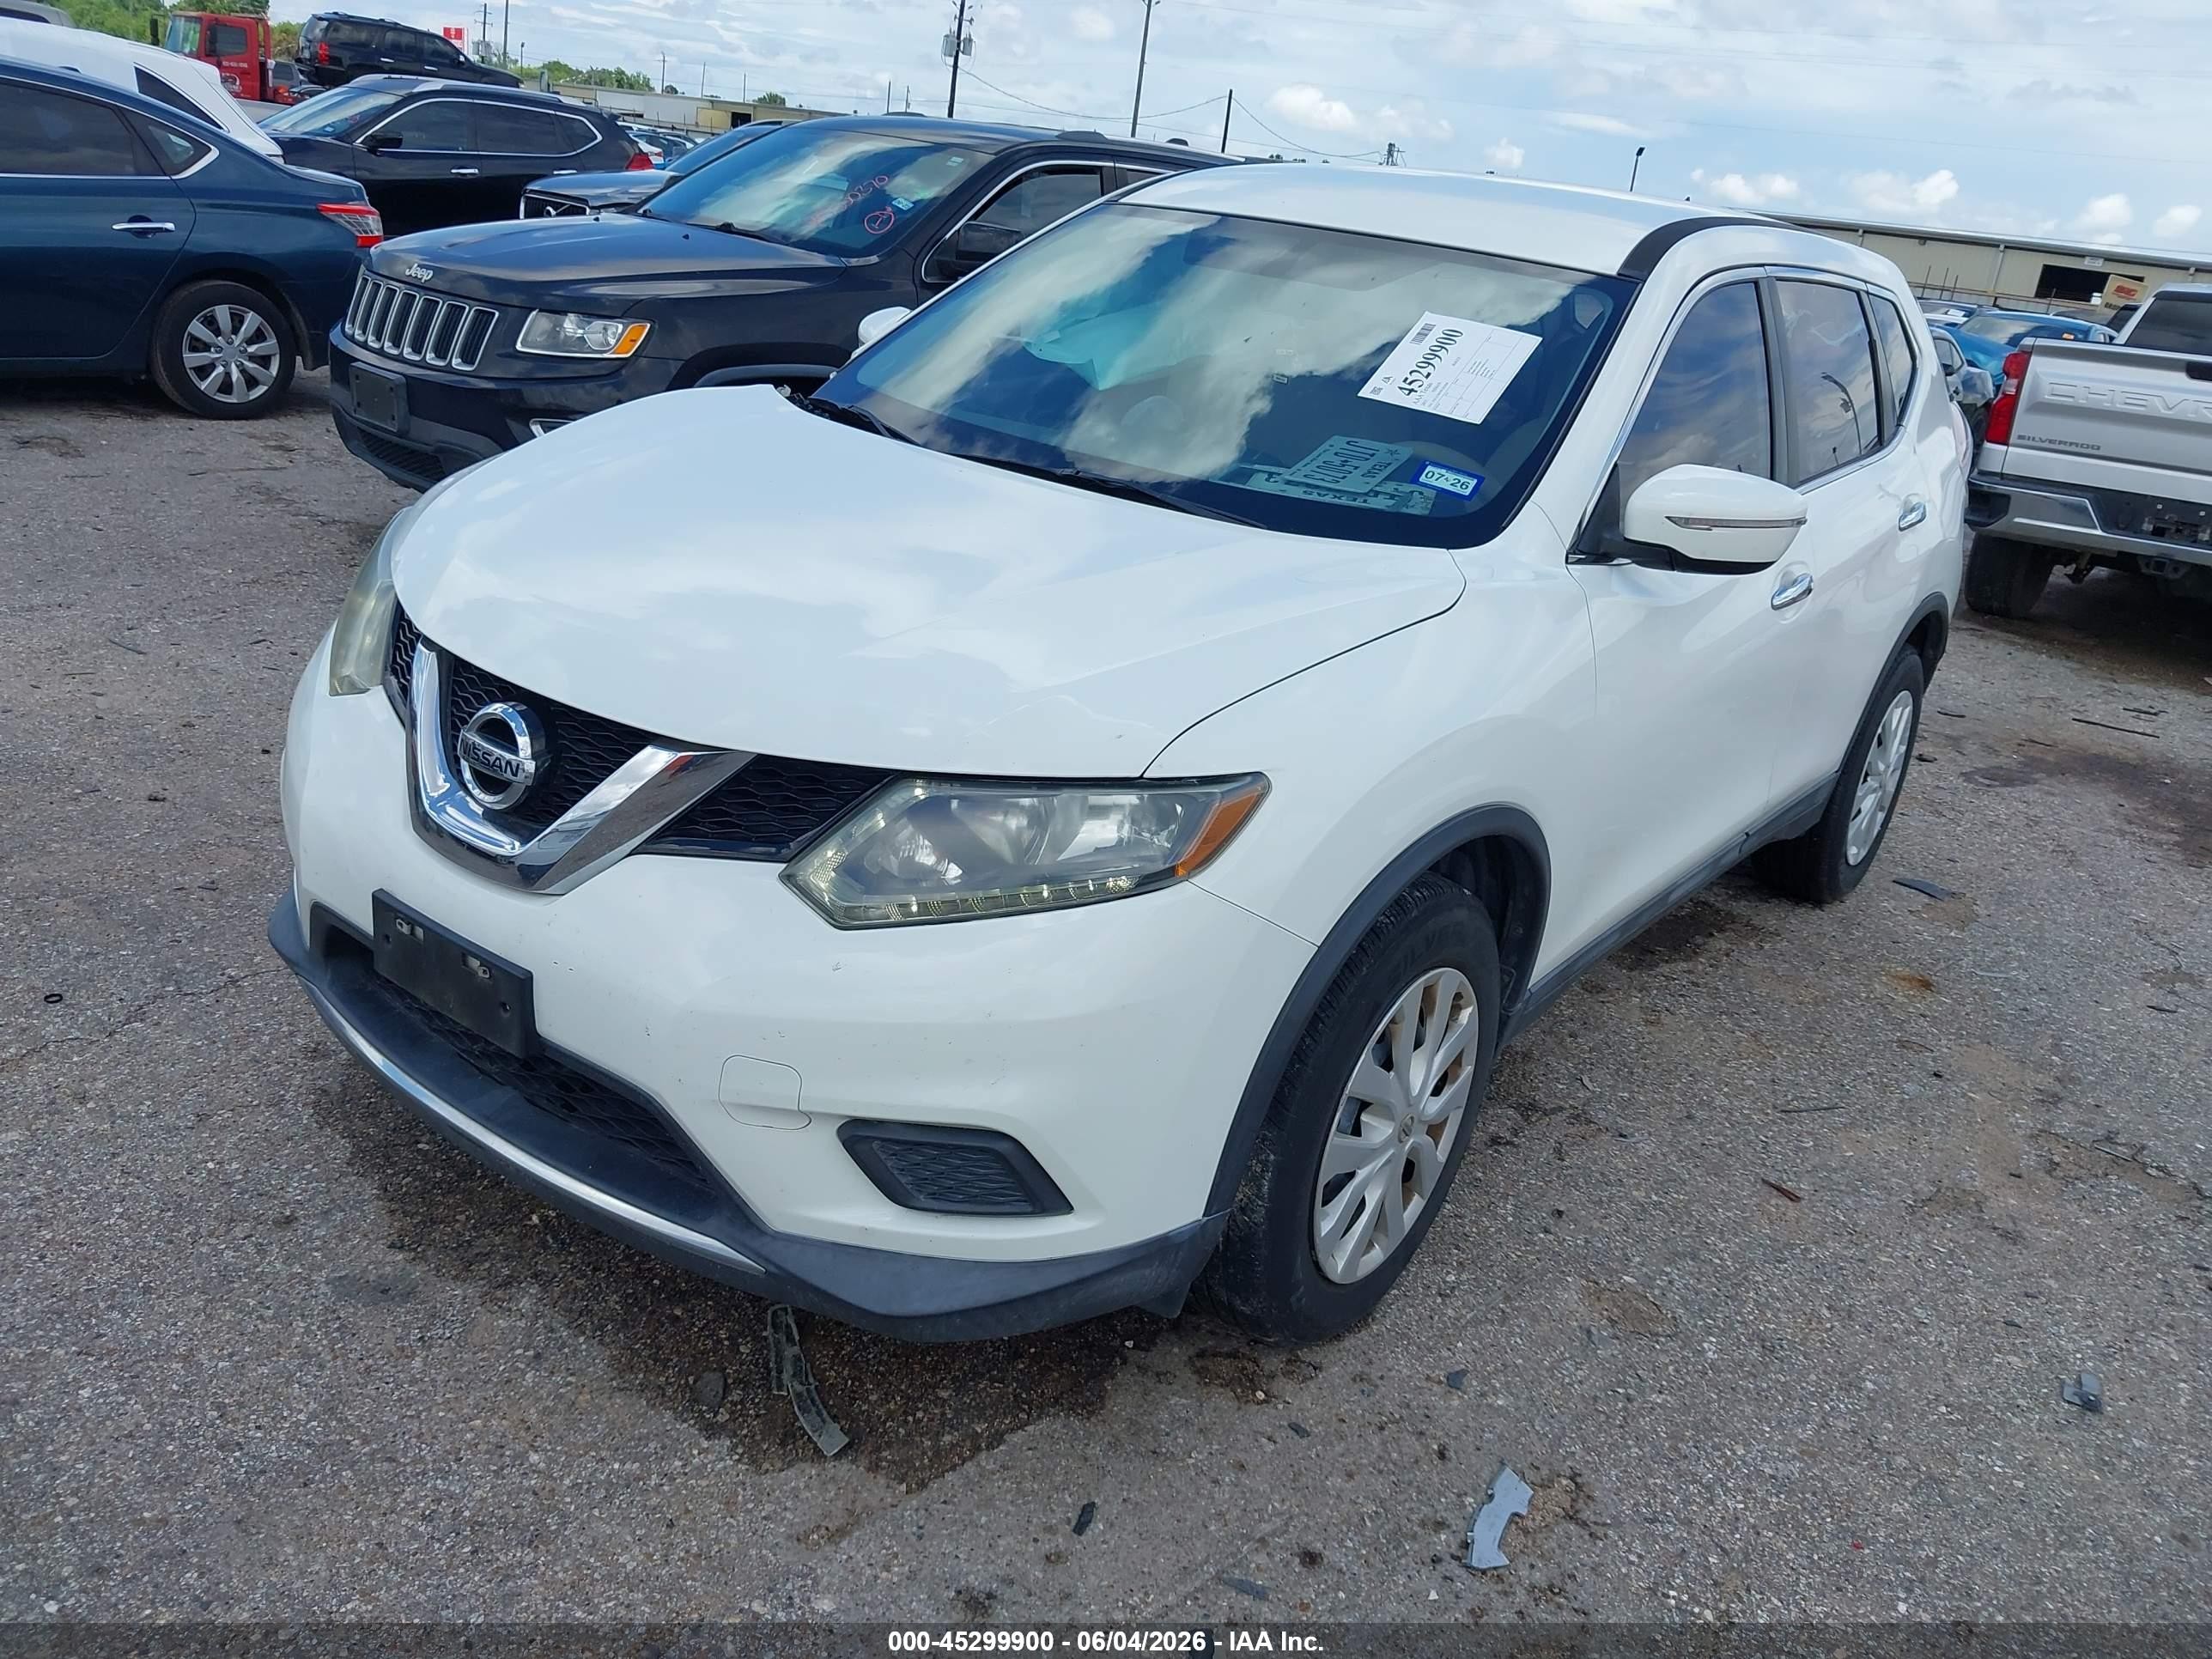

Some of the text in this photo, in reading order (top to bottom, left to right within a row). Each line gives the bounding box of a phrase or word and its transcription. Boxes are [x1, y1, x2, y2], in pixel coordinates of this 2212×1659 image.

[405, 263, 433, 283] Jeep
[1397, 329, 1463, 396] 45299900
[2017, 434, 2101, 451] SILVERADO
[1425, 471, 1471, 490] 07 26
[460, 738, 520, 778] NISSAN
